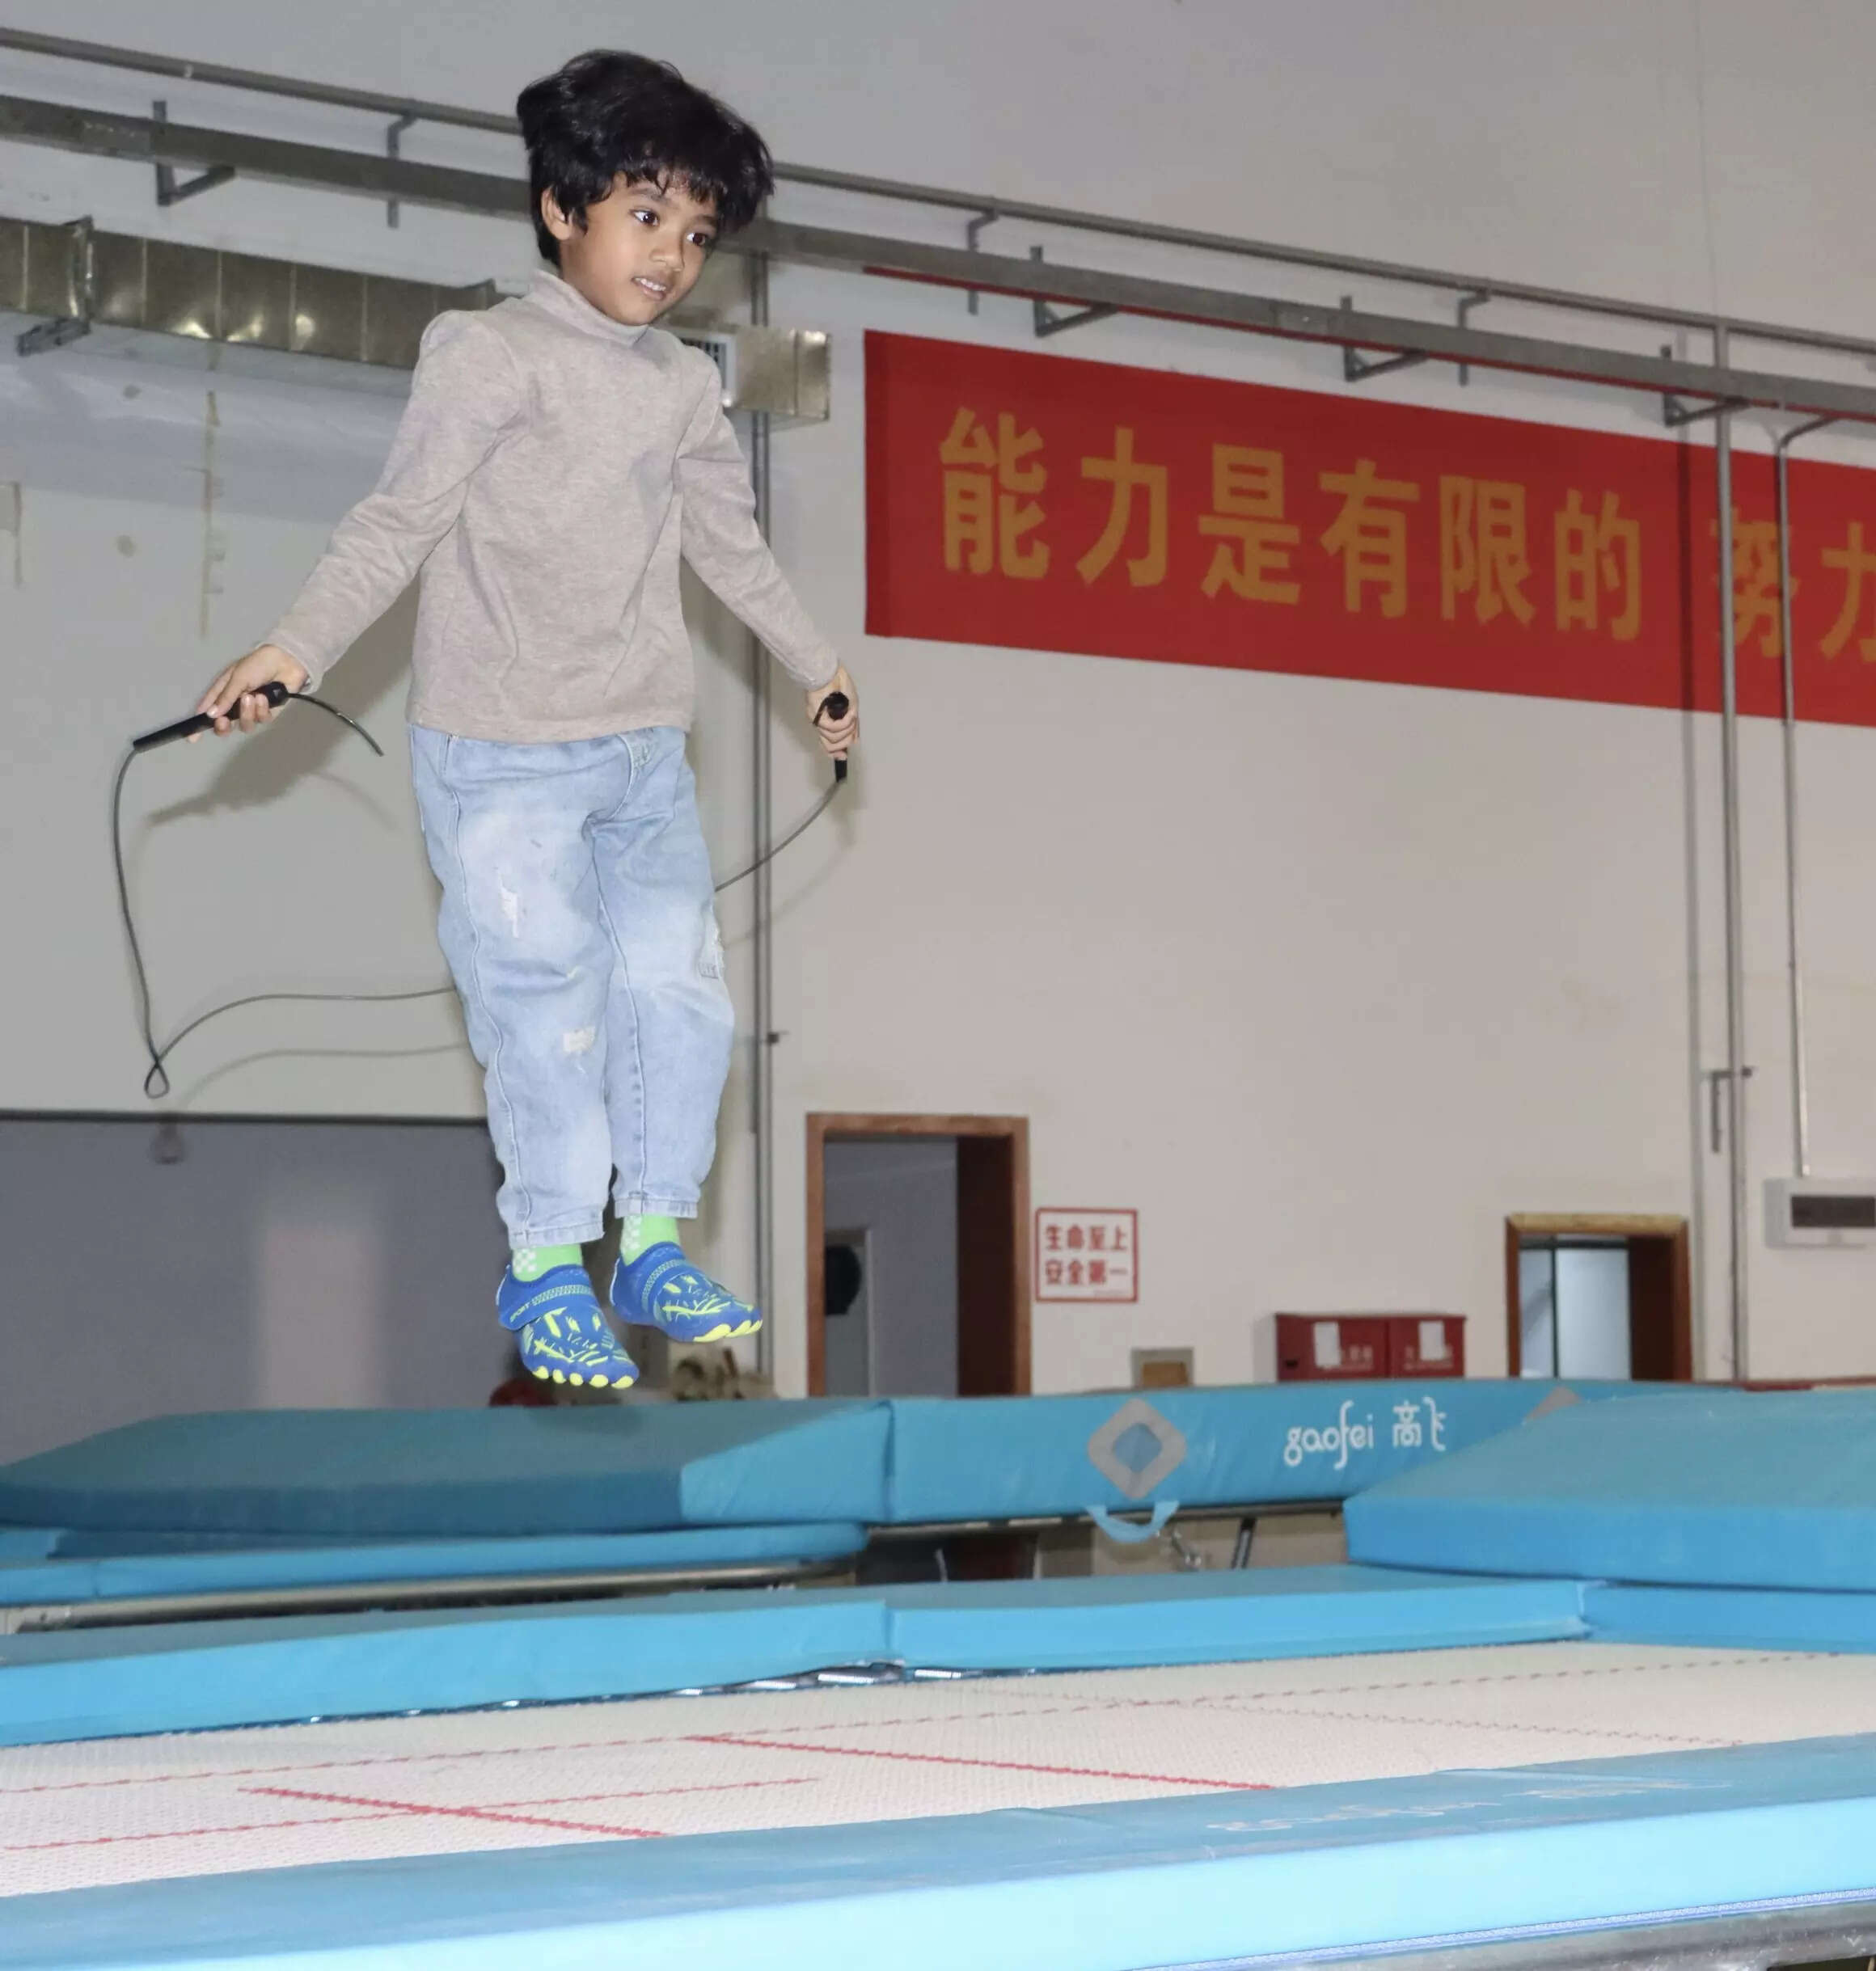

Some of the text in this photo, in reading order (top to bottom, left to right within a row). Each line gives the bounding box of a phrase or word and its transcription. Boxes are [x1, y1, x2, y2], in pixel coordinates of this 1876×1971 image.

[939, 406, 1642, 641] 能力是有限的
[1045, 1223, 1127, 1251] 生命至上
[1045, 1258, 1127, 1285] 安全第一
[1283, 1399, 1374, 1471] gaofei
